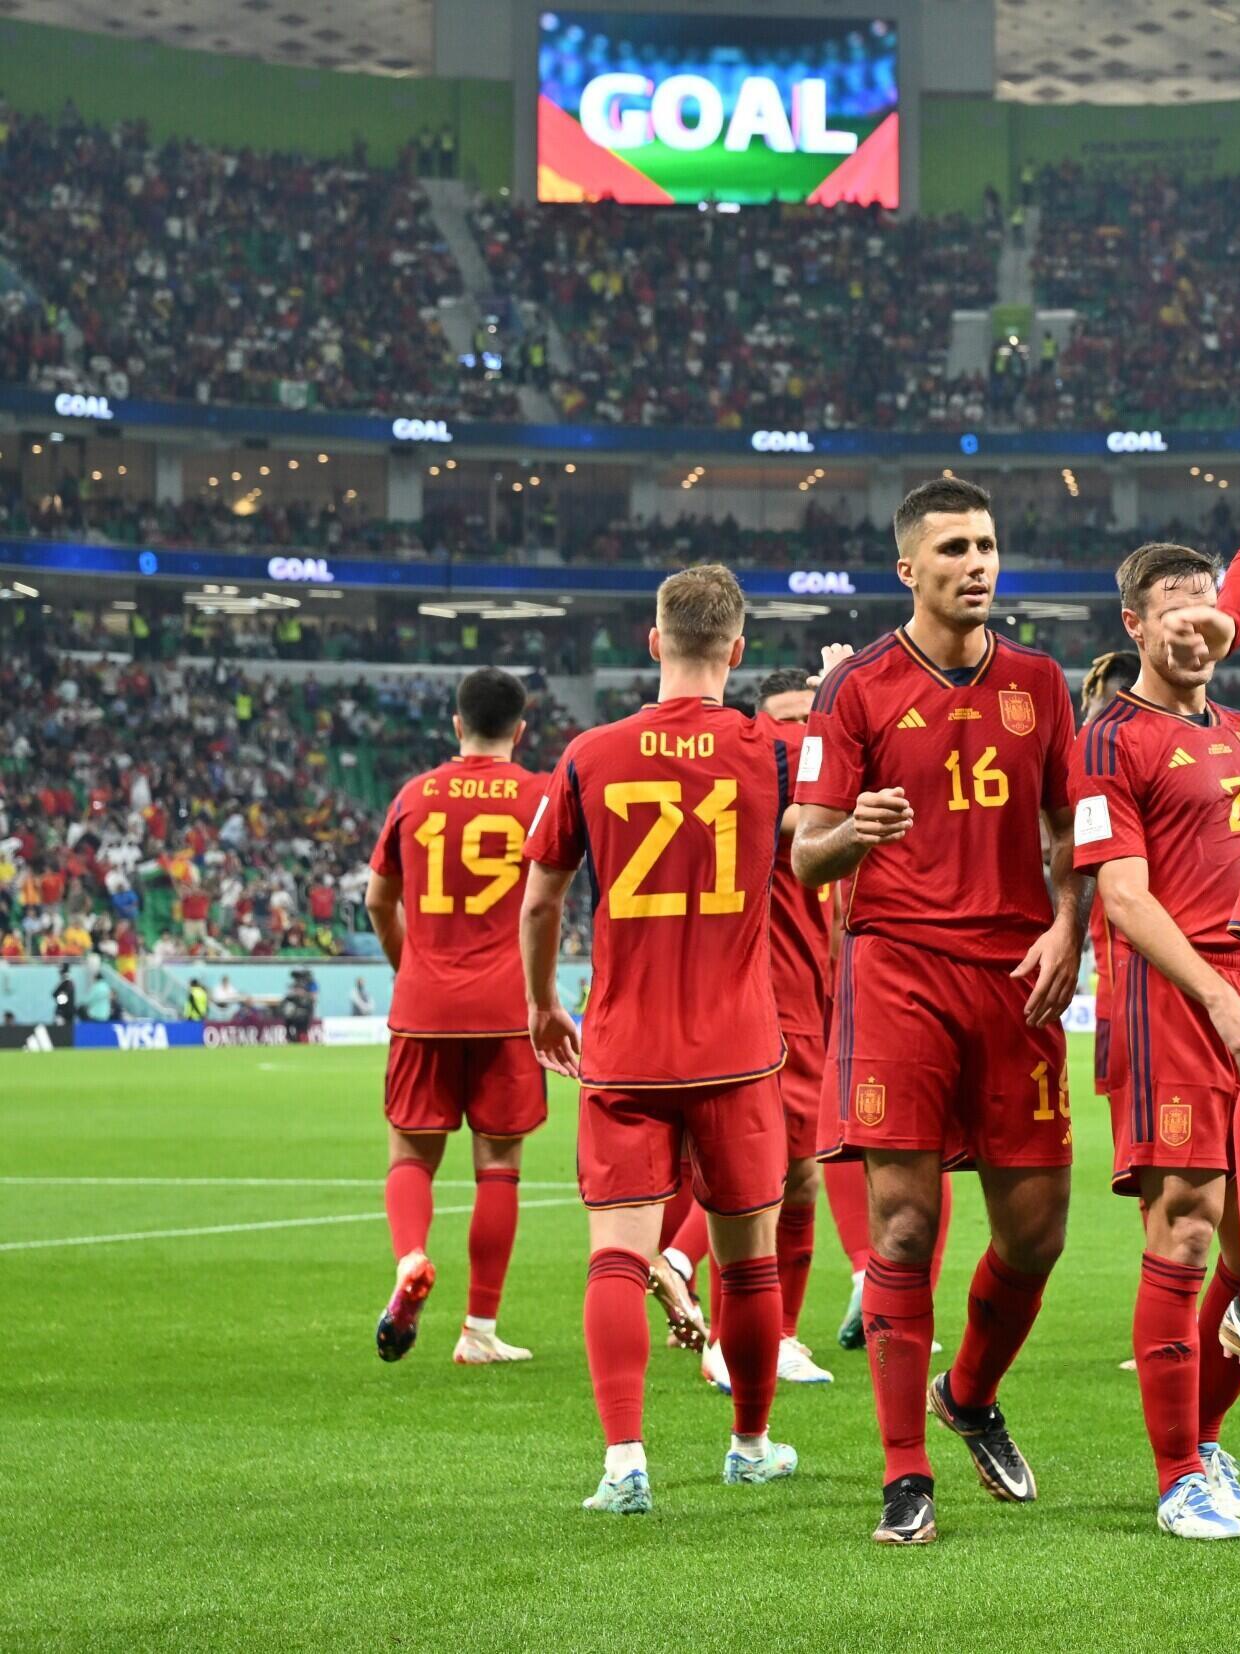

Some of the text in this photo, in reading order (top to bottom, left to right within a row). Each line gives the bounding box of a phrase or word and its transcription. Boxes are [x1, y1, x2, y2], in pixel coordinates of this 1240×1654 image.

[579, 73, 858, 154] GOAL
[55, 392, 114, 420] GOAL
[392, 418, 453, 442] GOAL
[751, 430, 815, 452] GOAL
[1106, 430, 1168, 453] GOAL
[267, 556, 335, 582] GOAL
[788, 570, 857, 595] GOAL
[640, 731, 715, 760] OLMO
[448, 778, 519, 800] SOLER
[945, 746, 1010, 811] 16
[414, 811, 526, 916] 19
[604, 779, 746, 920] 21
[112, 1022, 170, 1050] VISA
